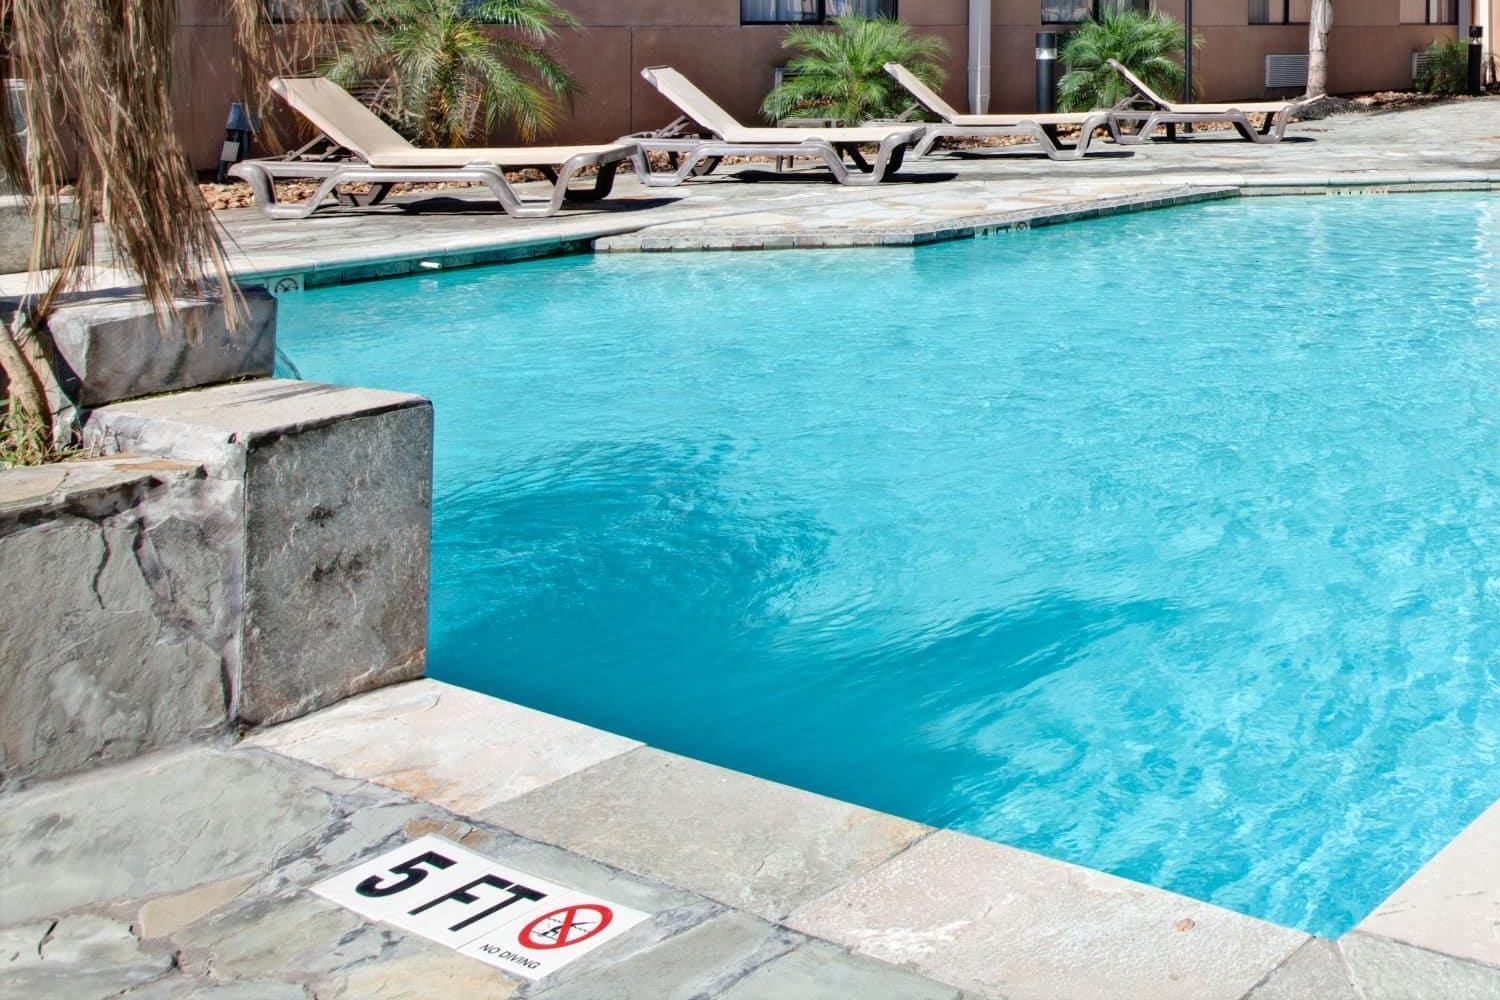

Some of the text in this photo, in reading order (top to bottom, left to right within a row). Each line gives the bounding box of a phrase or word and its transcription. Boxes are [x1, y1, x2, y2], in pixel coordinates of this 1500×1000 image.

[355, 850, 549, 932] 5 FT
[479, 943, 541, 969] NO DIVING
